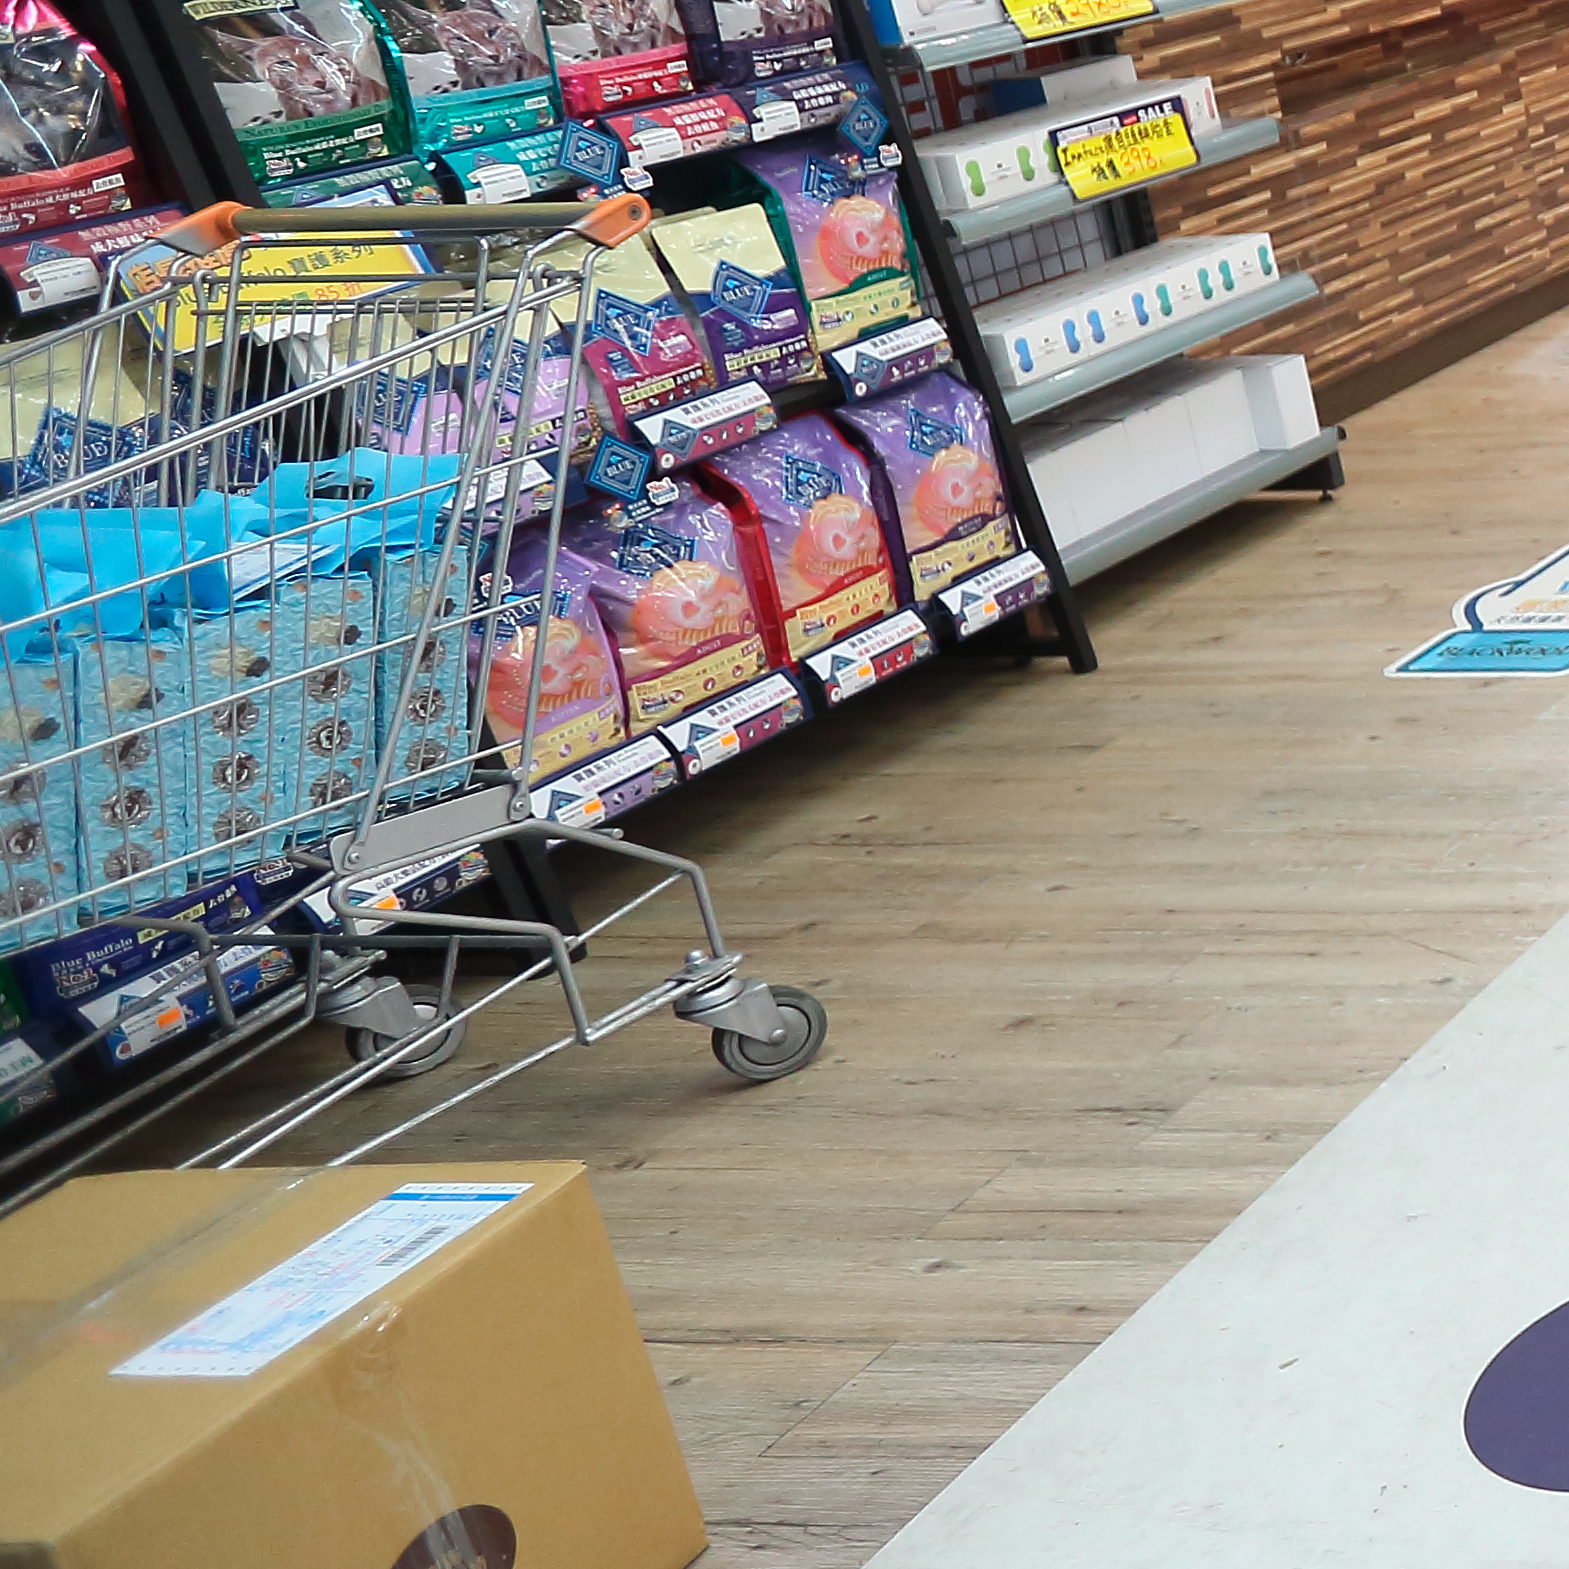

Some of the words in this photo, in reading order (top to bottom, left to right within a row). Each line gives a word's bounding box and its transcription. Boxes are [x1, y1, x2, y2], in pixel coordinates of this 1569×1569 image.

[1137, 102, 1175, 121] SALE
[314, 283, 341, 302] 85
[605, 458, 633, 478] BLUE
[50, 955, 84, 973] Blue
[85, 934, 135, 959] Buffalo
